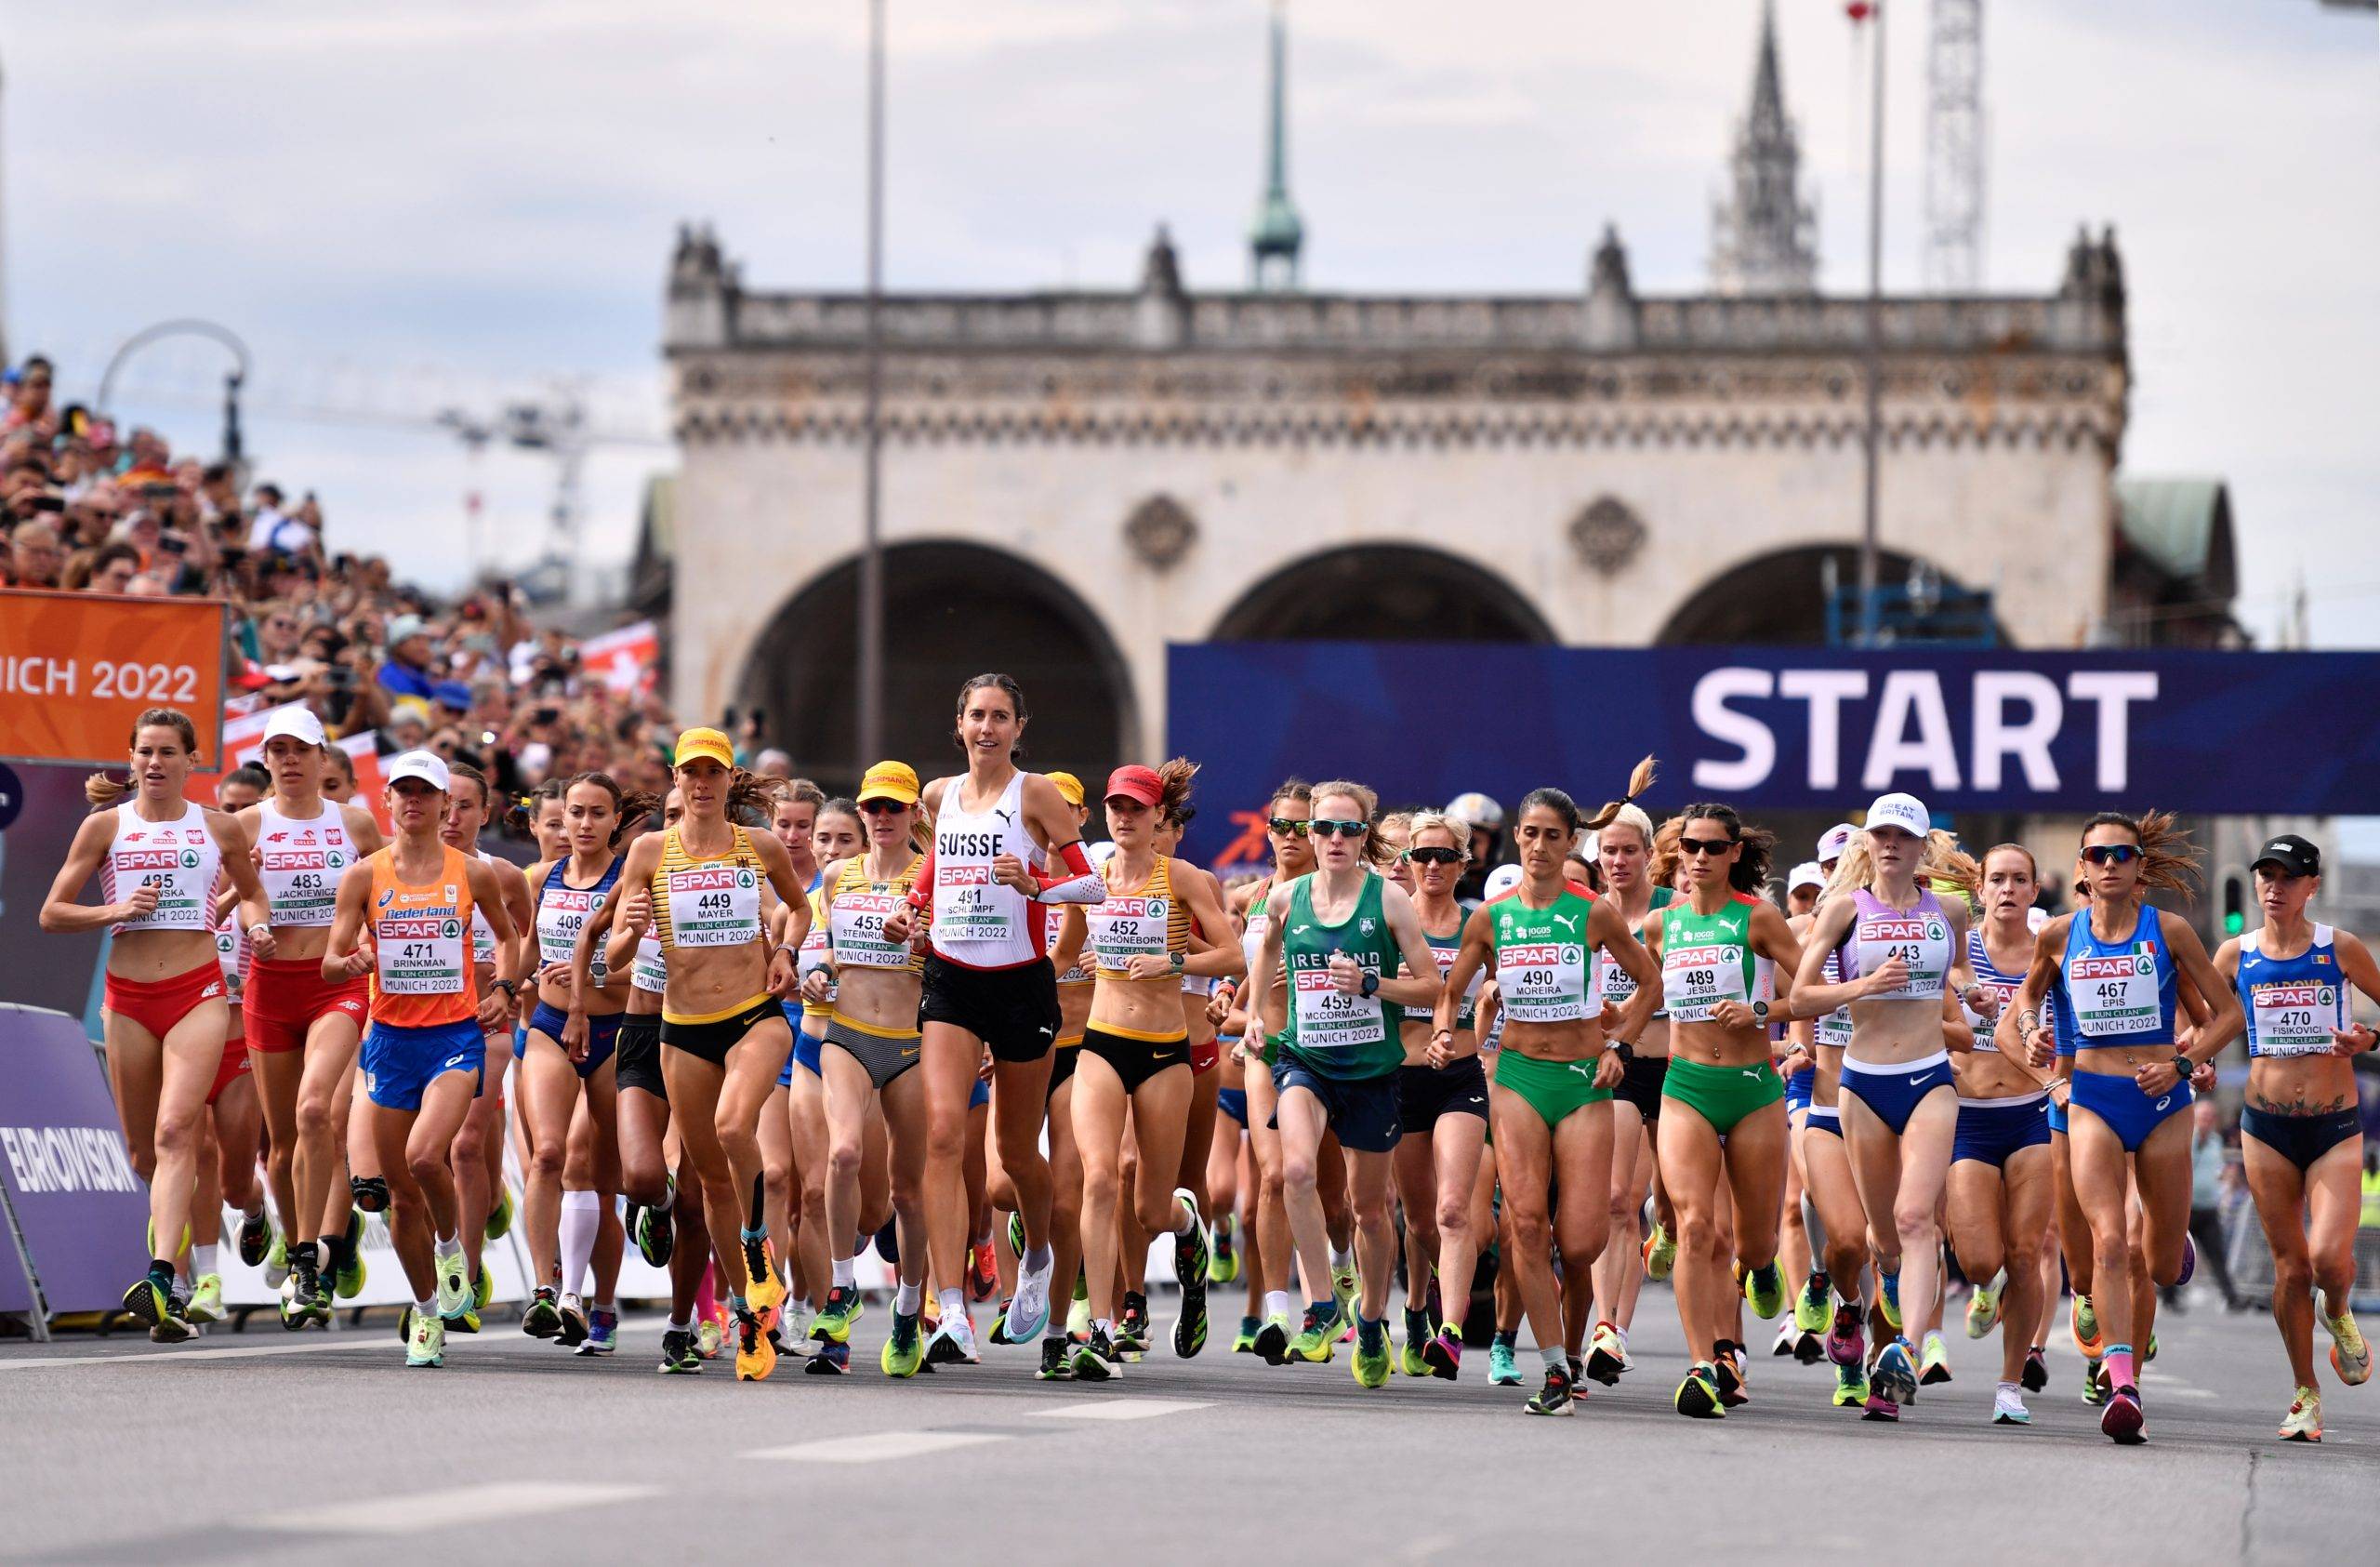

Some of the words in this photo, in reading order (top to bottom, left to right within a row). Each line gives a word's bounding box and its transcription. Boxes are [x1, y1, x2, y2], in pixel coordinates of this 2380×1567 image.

[0, 656, 77, 696] ICH
[92, 660, 198, 702] 2022
[1691, 668, 2159, 792] START
[867, 776, 907, 786] GERMANY
[1879, 809, 1915, 820] BRITAIN
[1880, 803, 1915, 814] GREAT
[117, 852, 177, 869] SPAR
[267, 853, 324, 869] SPAR
[292, 874, 322, 888] 483
[672, 871, 734, 890] SPAR
[940, 867, 987, 884] SPAR
[277, 888, 337, 899] JACKIEWICZ
[959, 889, 981, 904] 491
[547, 894, 588, 910] SPAR
[699, 894, 731, 909] 449
[835, 896, 892, 911] SPAR
[1091, 900, 1143, 914] SPAR
[171, 910, 199, 920] 2022
[270, 910, 315, 922] MUNICH
[698, 910, 734, 919] MAYER
[947, 905, 995, 914] SCHLUMPF
[557, 915, 583, 929] 408
[854, 916, 883, 931] 453
[1110, 922, 1138, 936] 452
[381, 923, 439, 937] SPAR
[538, 927, 568, 937] PARLOV
[679, 933, 724, 943] MUNICH
[729, 931, 756, 942] 2022
[939, 926, 973, 937] MUNICH
[978, 927, 1007, 937] 2022
[1861, 923, 1924, 939] SPAR
[1099, 934, 1164, 944] SCHÖNEBORN
[403, 944, 433, 959] 471
[837, 949, 872, 963] MUNICH
[876, 953, 905, 964] 2022
[1501, 949, 1558, 965] SPAR
[1665, 949, 1718, 968] SPAR
[1888, 945, 1920, 960] 443
[393, 960, 446, 968] BRINKMAN
[2072, 960, 2132, 976] SPAR
[1523, 971, 1553, 985] 490
[1609, 969, 1634, 982] 45
[1686, 970, 1714, 986] 489
[385, 980, 428, 990] MUNICH
[432, 979, 458, 989] 2022
[1516, 986, 1562, 994] MOREIRA
[1686, 985, 1717, 995] JESUS
[1916, 981, 1937, 992] 2022
[2097, 982, 2128, 998] 467
[1321, 996, 1353, 1010] 459
[1685, 998, 1700, 1006] RUN
[2103, 999, 2126, 1008] EPIS
[2256, 991, 2314, 1005] SPAR
[1305, 1008, 1371, 1020] MCCORMACK
[1508, 1006, 1548, 1017] MUNICH
[1552, 1005, 1580, 1017] 2022
[2082, 1020, 2124, 1031] MUNICH
[2129, 1016, 2157, 1029] 2022
[2281, 1012, 2310, 1026] 470
[1302, 1030, 1347, 1043] MUNICH
[1352, 1029, 1380, 1041] 2022
[2272, 1026, 2321, 1035] FISIKOVICI
[2263, 1047, 2306, 1057] MUNICH
[0, 1127, 138, 1193] EUROVISION
